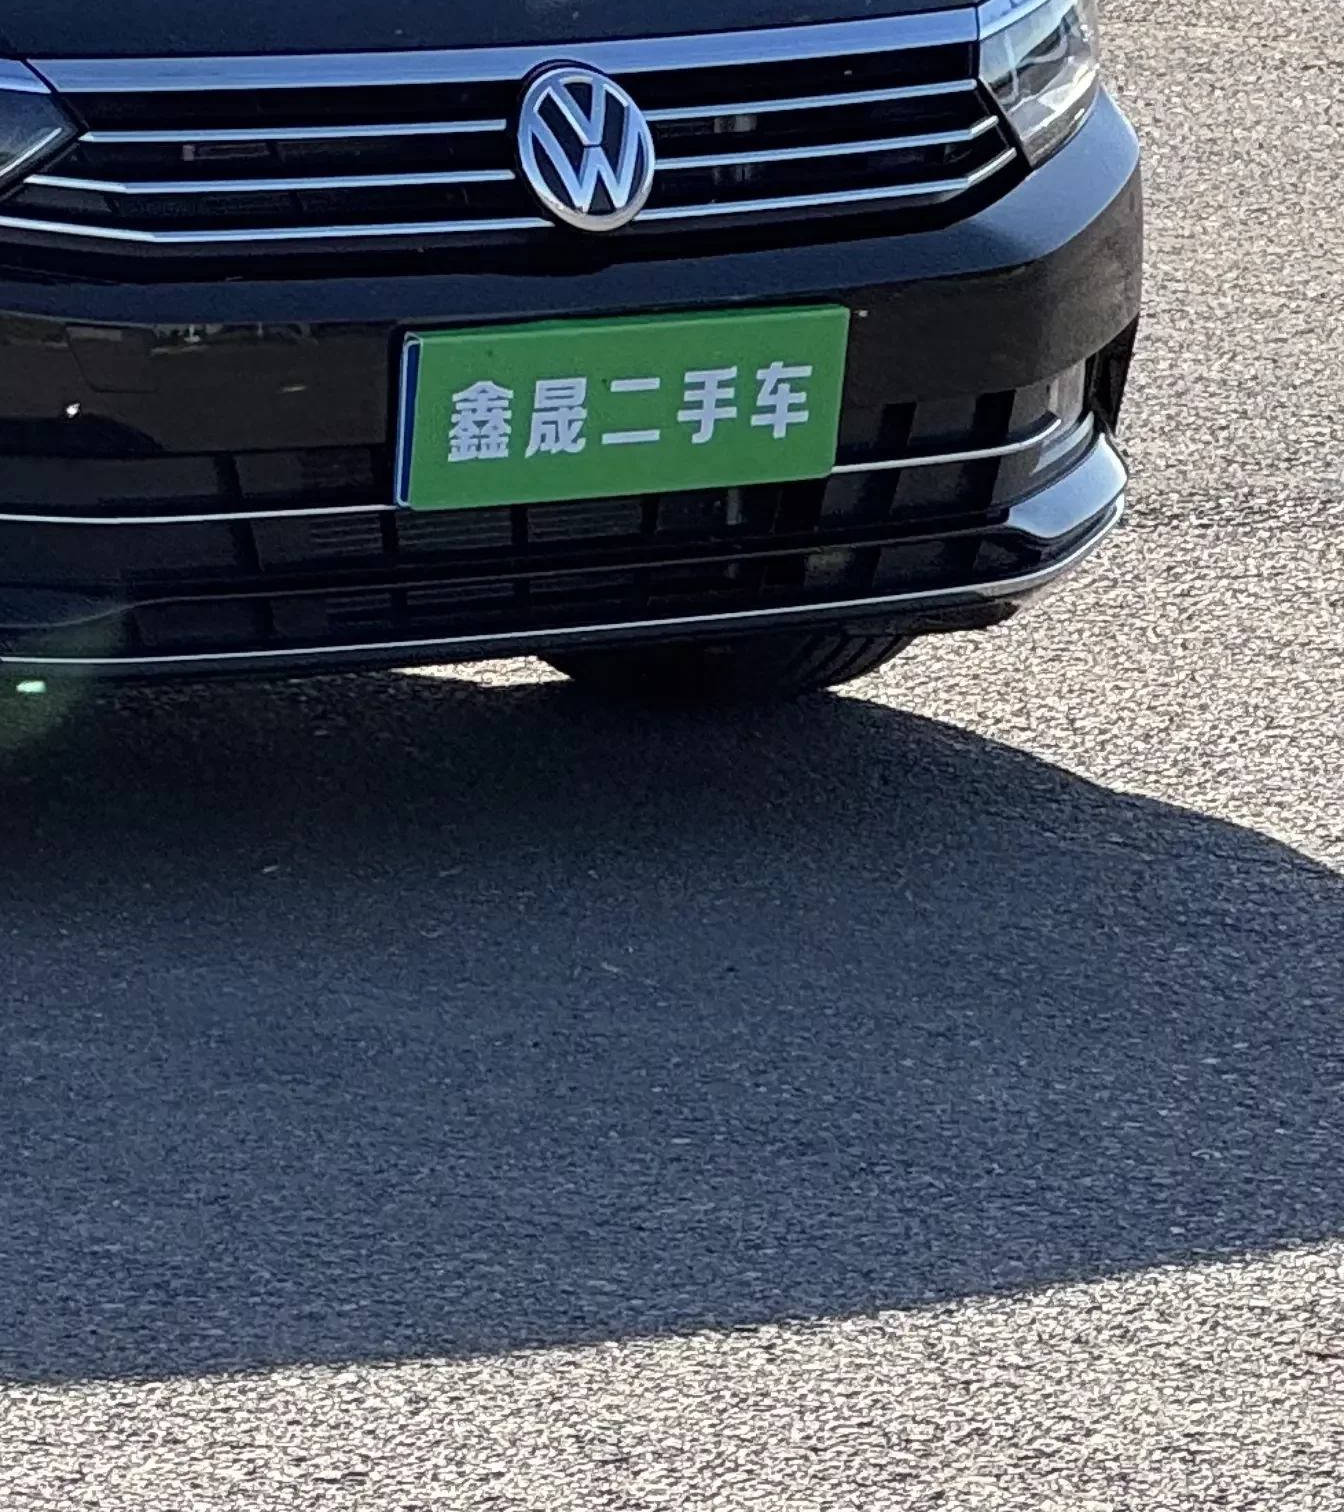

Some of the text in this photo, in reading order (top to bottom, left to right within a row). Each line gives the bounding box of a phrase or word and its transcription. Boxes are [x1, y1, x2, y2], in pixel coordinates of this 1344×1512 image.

[522, 71, 650, 223] VW
[447, 360, 814, 464] 鑫晟二手车
